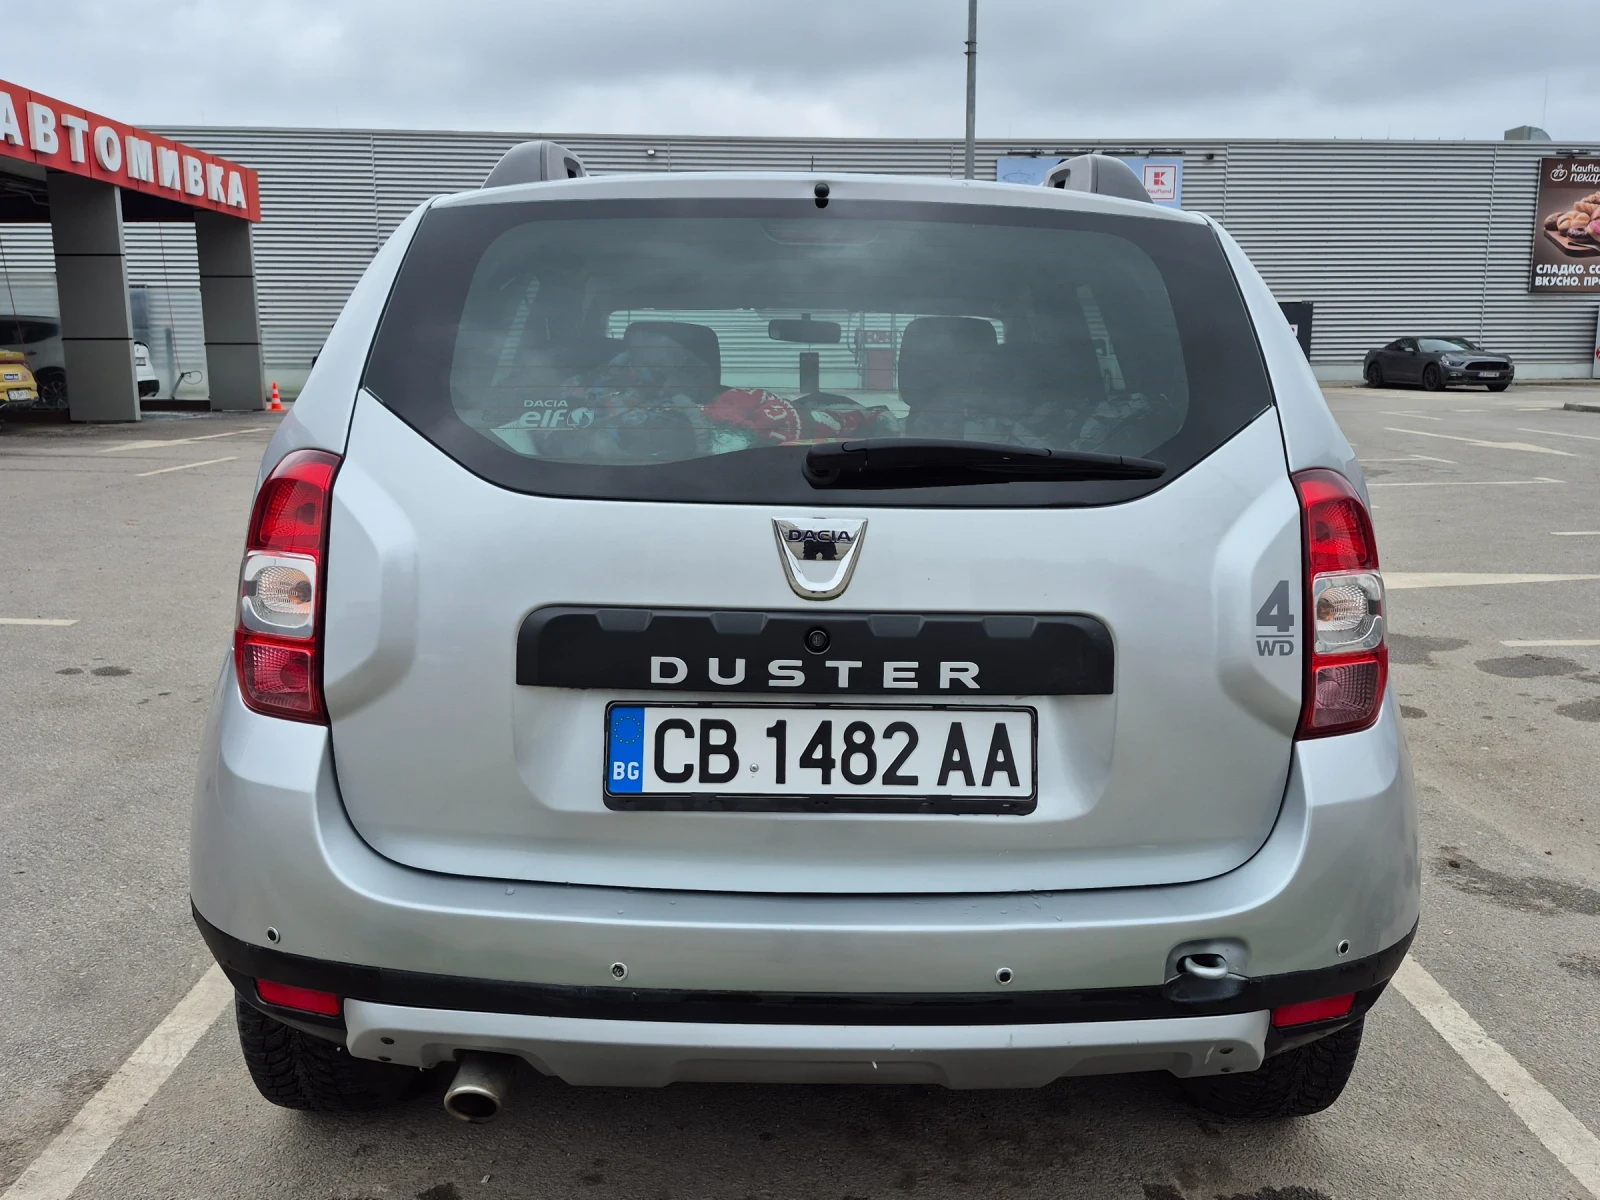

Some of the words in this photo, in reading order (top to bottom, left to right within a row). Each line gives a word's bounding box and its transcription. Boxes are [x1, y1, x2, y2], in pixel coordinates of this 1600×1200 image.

[0, 91, 247, 209] АВТОМИВКА
[1536, 264, 1586, 276] СЛАДКО.
[1535, 276, 1581, 287] ВКУСНО.
[1584, 276, 1600, 287] ПР
[523, 399, 569, 408] DACIA
[519, 409, 568, 428] elf
[788, 529, 852, 542] DACIA
[1255, 580, 1295, 633] 4
[1256, 639, 1295, 657] WD
[650, 656, 981, 689] DUSTER
[653, 718, 740, 784] CB
[766, 719, 919, 786] 1482
[937, 721, 1020, 787] AA
[612, 761, 640, 781] BG
